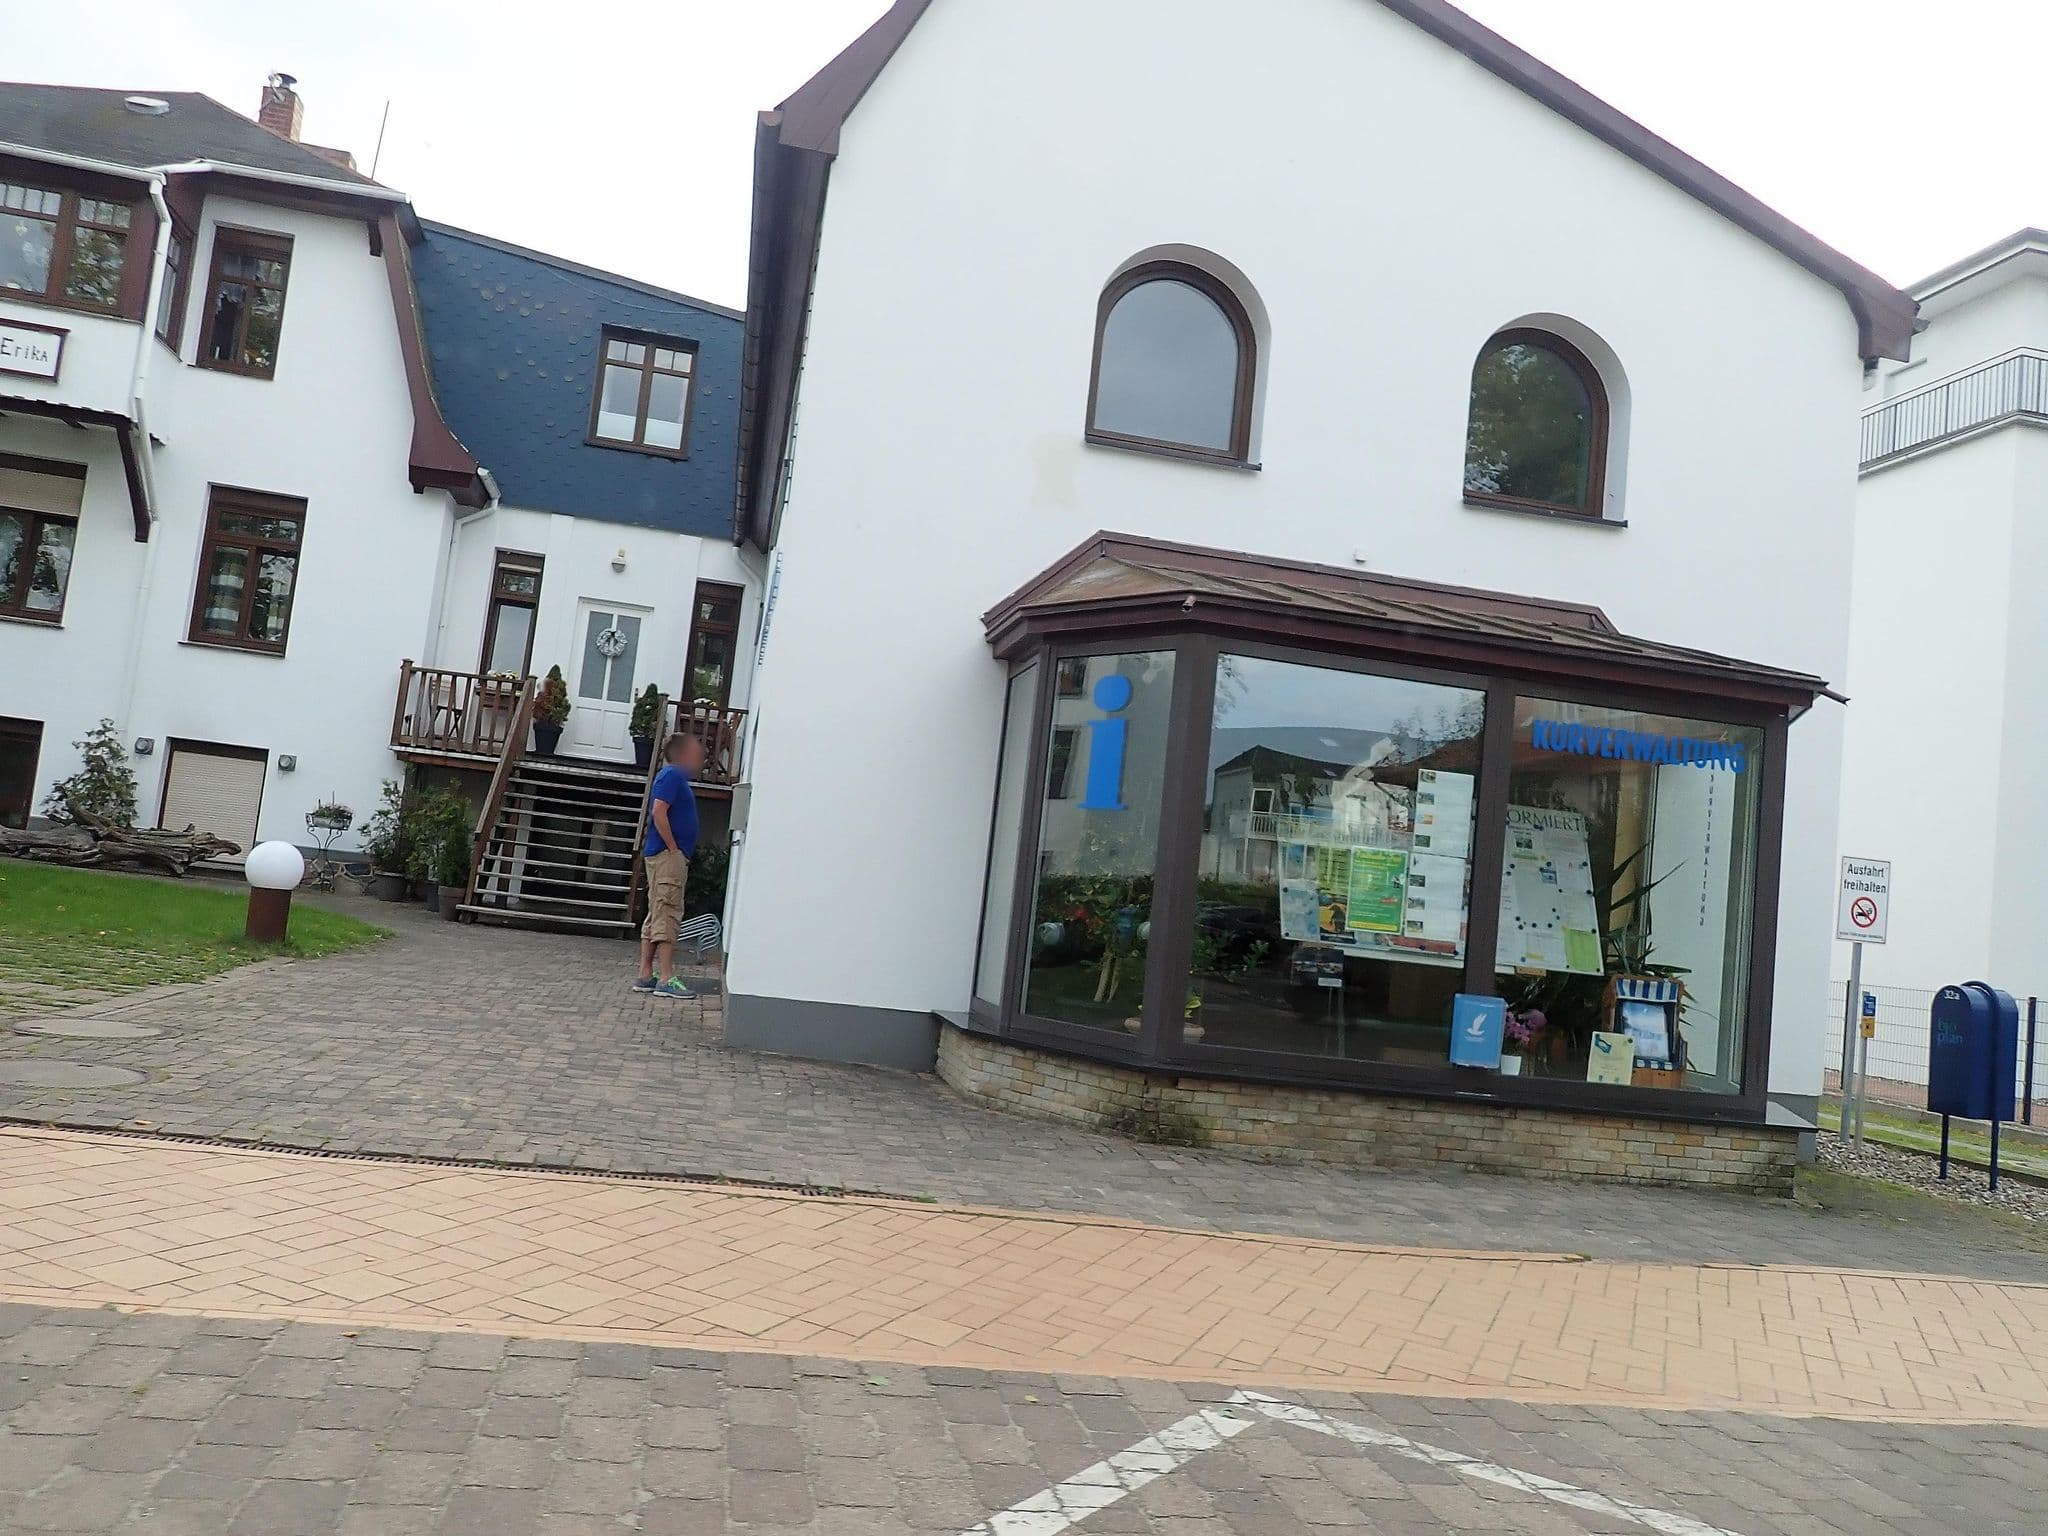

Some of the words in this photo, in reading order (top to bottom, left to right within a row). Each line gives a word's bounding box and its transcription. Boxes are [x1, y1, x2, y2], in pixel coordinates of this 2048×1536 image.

[1532, 719, 1745, 774] KURVERWALTUNG
[1847, 863, 1884, 878] Ausfahrt
[1843, 879, 1887, 894] freihalten
